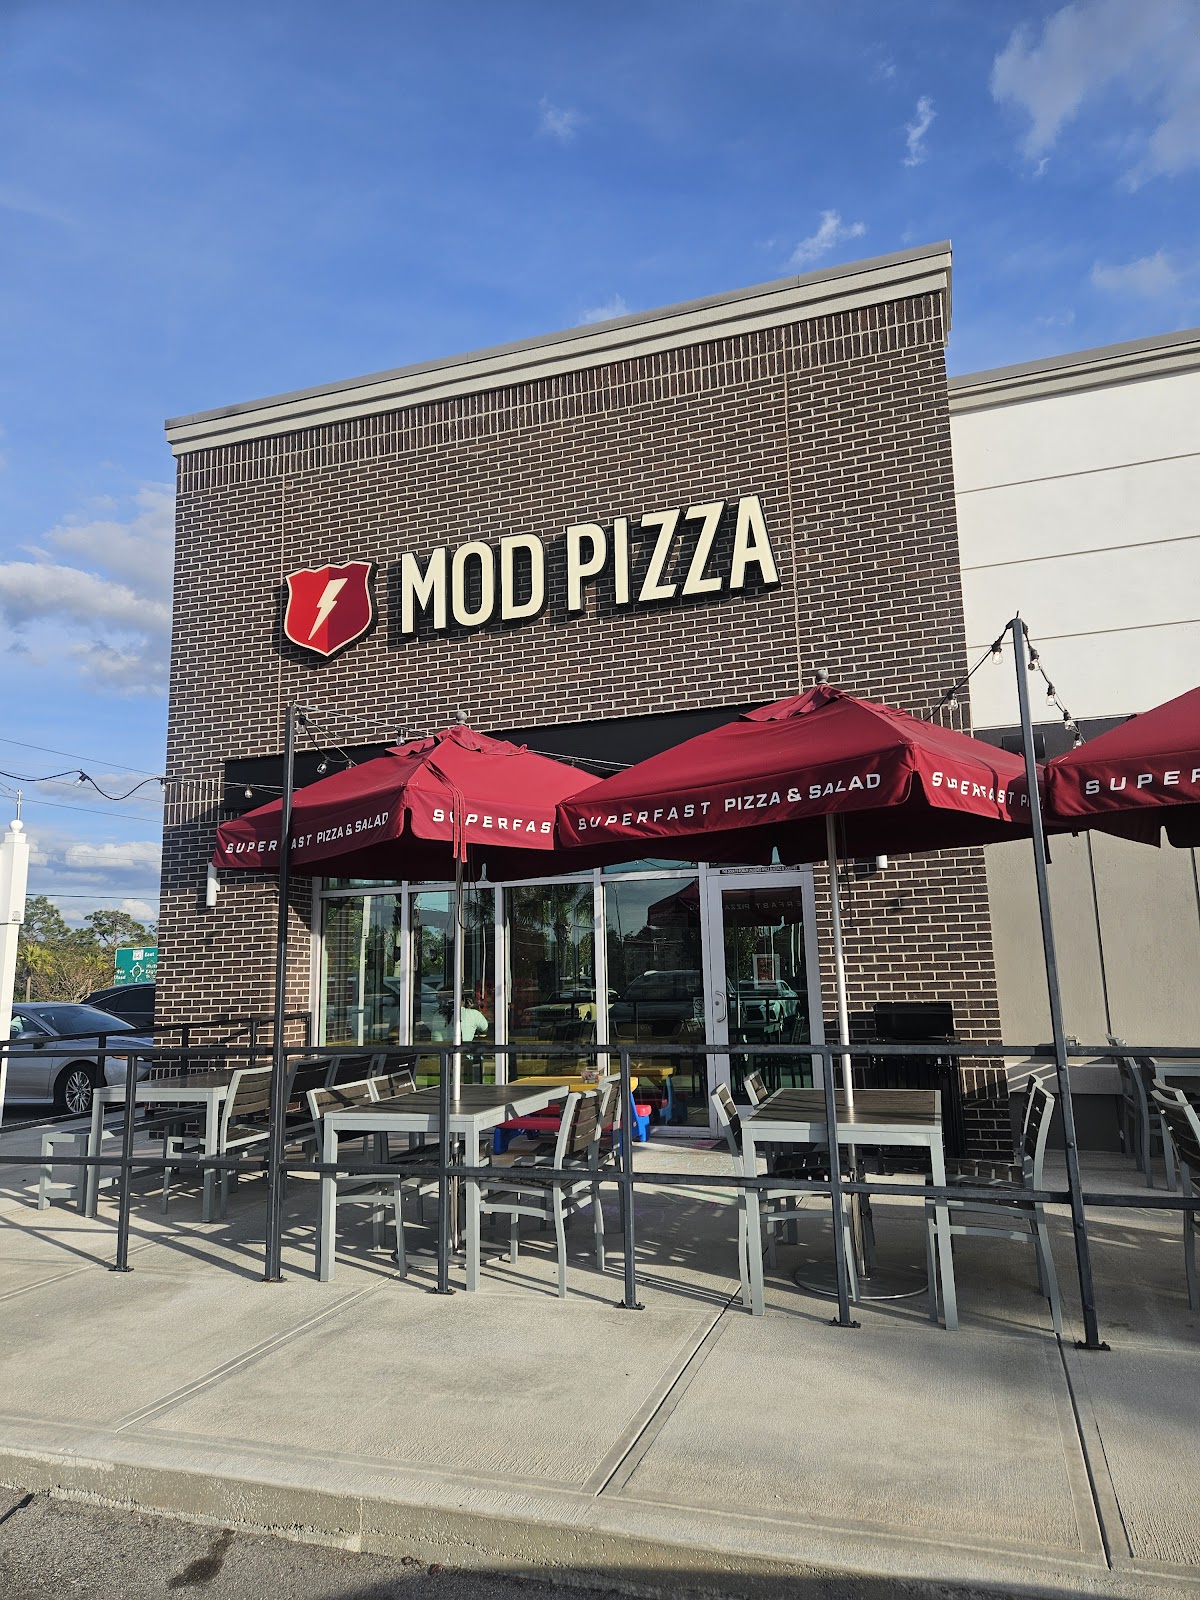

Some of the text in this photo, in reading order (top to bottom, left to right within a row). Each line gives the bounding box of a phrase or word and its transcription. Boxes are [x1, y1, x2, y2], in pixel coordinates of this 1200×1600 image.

[401, 495, 779, 634] MOD PIZZA
[432, 809, 551, 834] SPERFAS
[578, 773, 882, 831] SUPERFAST PIZZA & SALAD
[225, 812, 389, 854] SUPERAST PIZZA & SALAD
